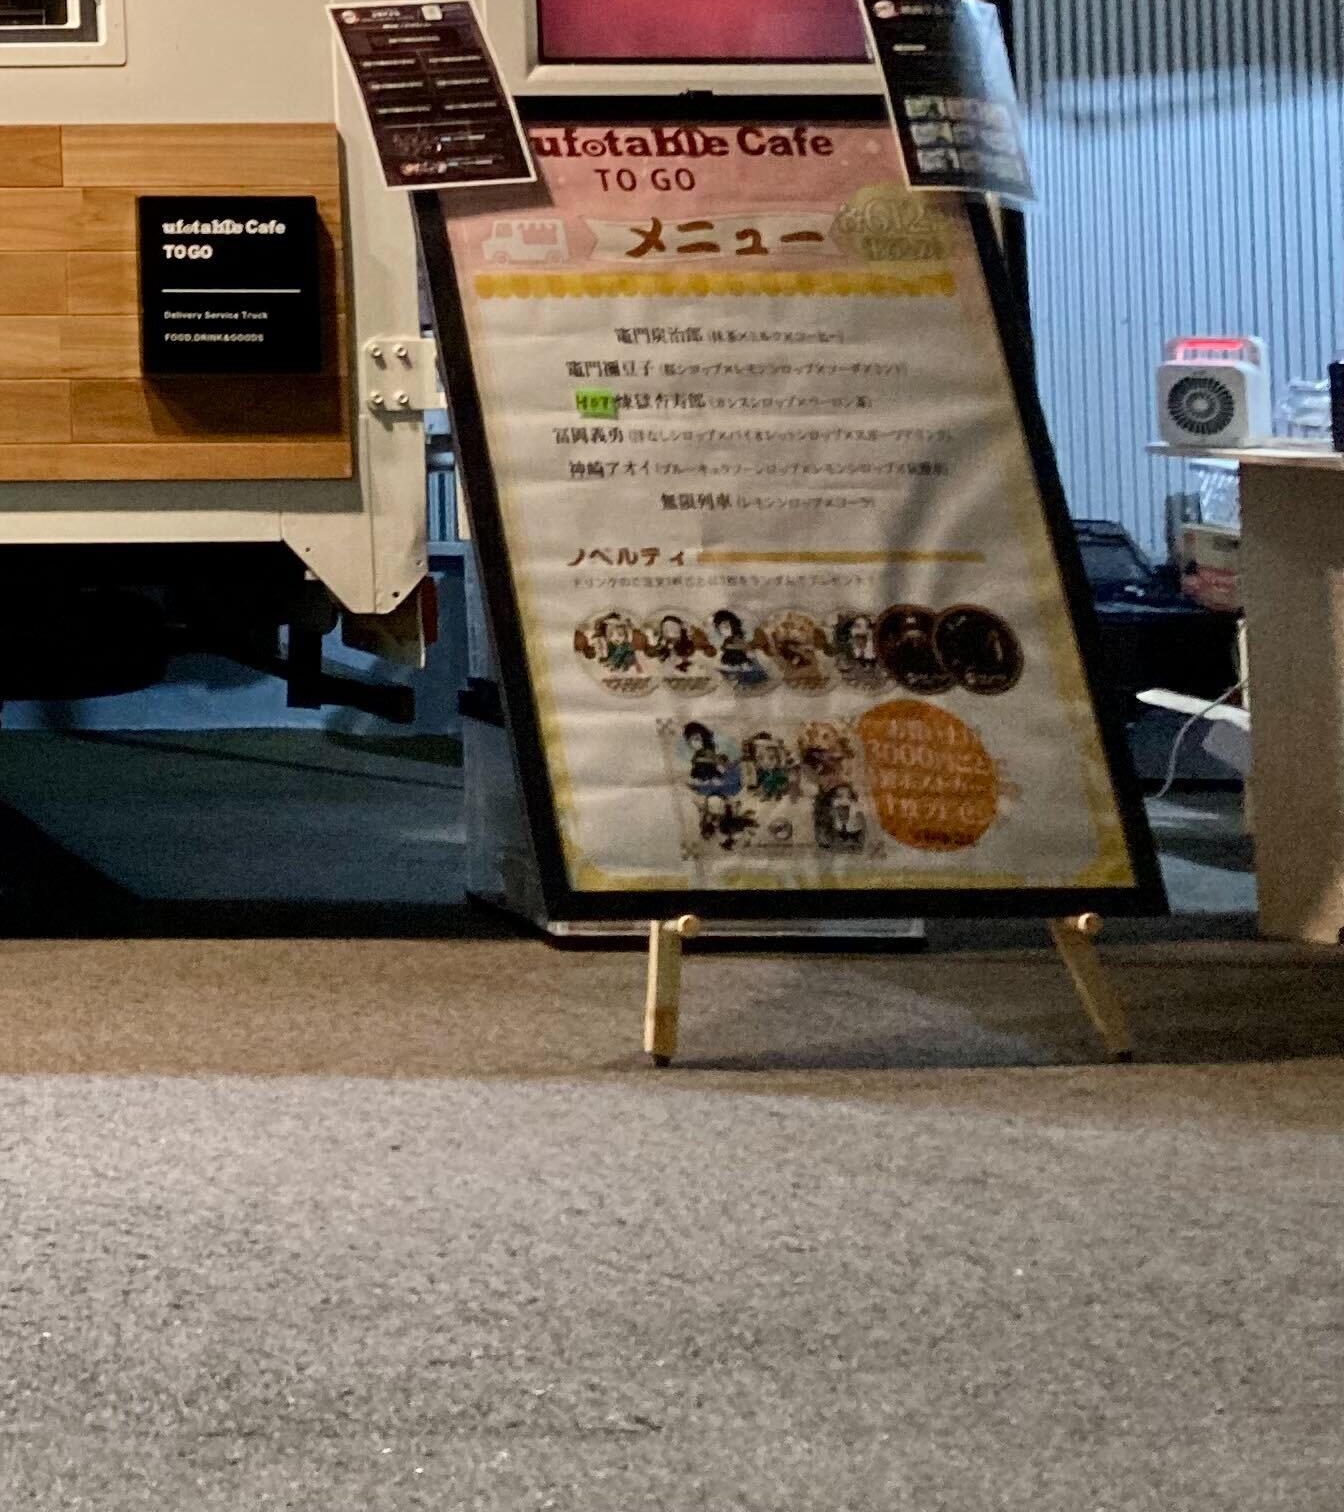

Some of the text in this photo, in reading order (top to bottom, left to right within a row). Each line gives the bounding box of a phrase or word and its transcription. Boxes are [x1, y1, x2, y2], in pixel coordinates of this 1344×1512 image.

[737, 125, 835, 157] Cafe
[593, 167, 697, 192] TO GO
[245, 219, 286, 234] Cafe
[625, 215, 826, 259] メニュー
[241, 311, 268, 319] Truck
[567, 546, 685, 568] ノベルティ
